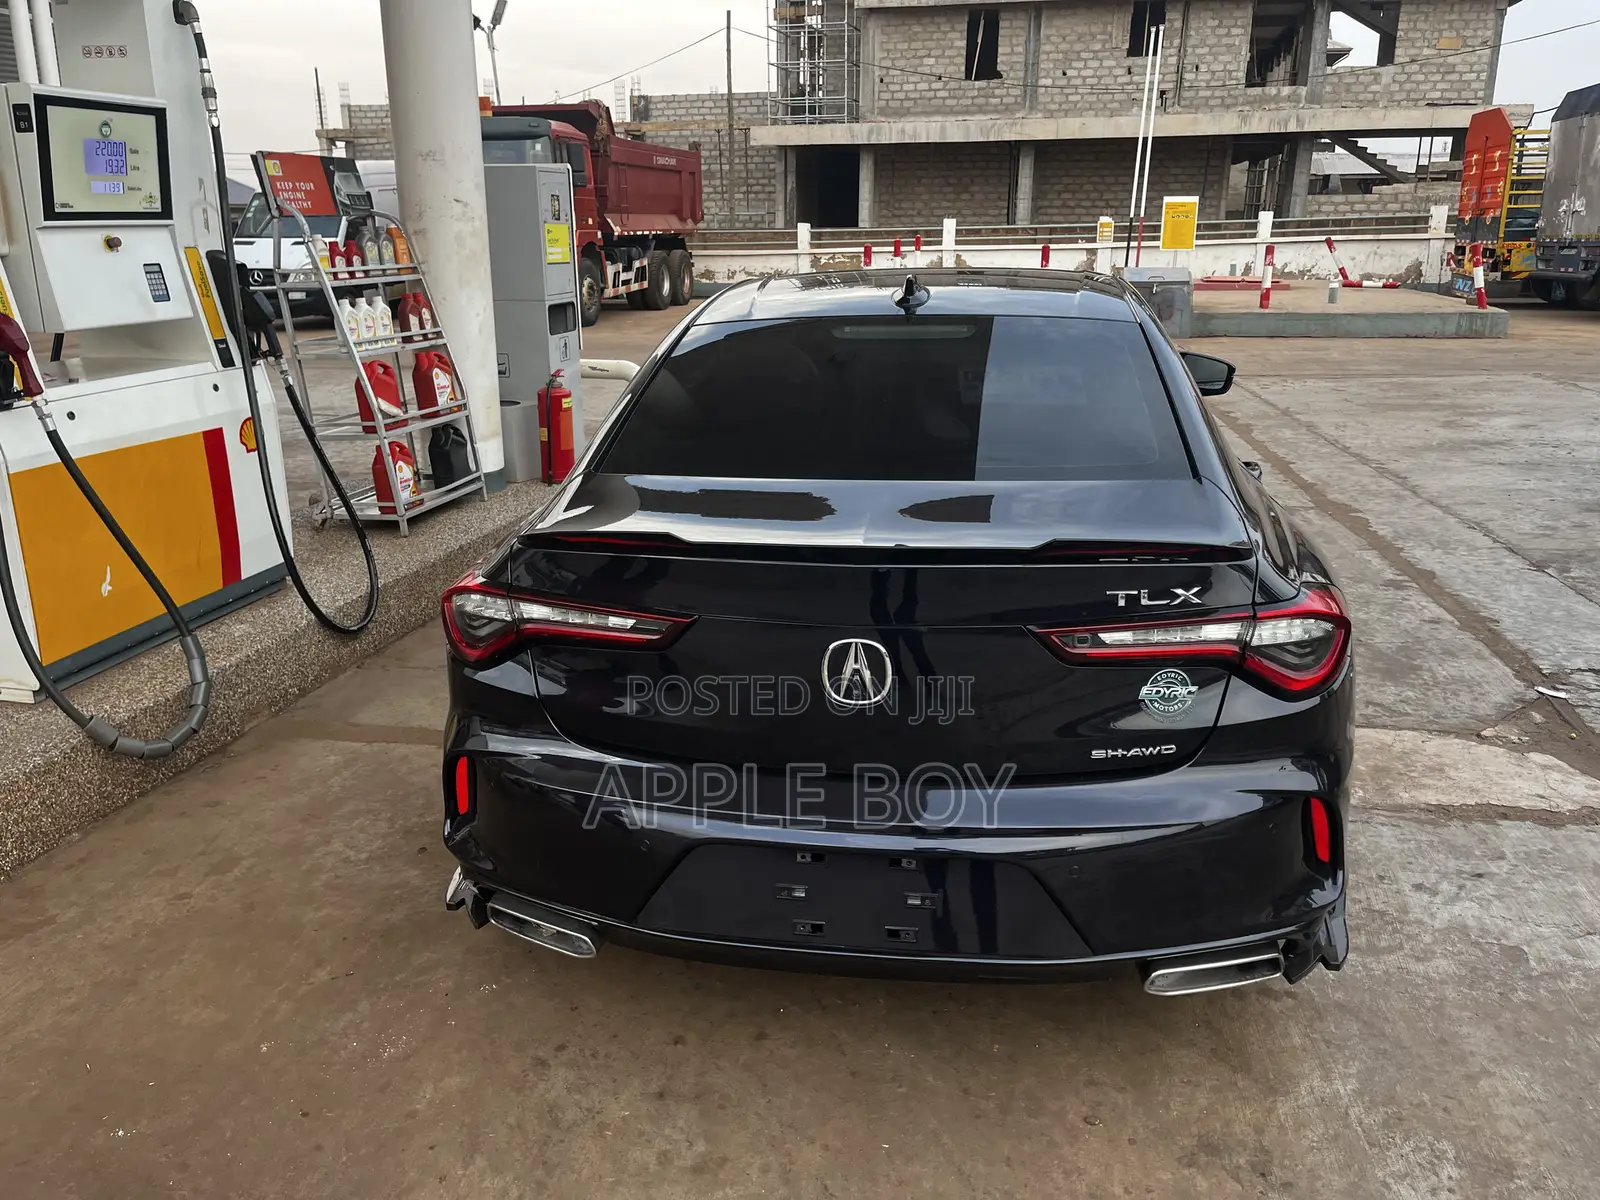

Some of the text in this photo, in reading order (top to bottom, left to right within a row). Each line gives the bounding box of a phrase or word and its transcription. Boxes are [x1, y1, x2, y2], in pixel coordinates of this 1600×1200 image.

[20, 121, 28, 129] B1
[275, 181, 315, 191] KEEP YOUR
[279, 191, 306, 200] ENGINE
[1106, 586, 1203, 607] TLX
[1156, 672, 1184, 682] EDYRIC
[1141, 687, 1198, 699] EDYRIC
[1152, 701, 1183, 712] MOTORS
[1089, 744, 1177, 759] SH-AWD
